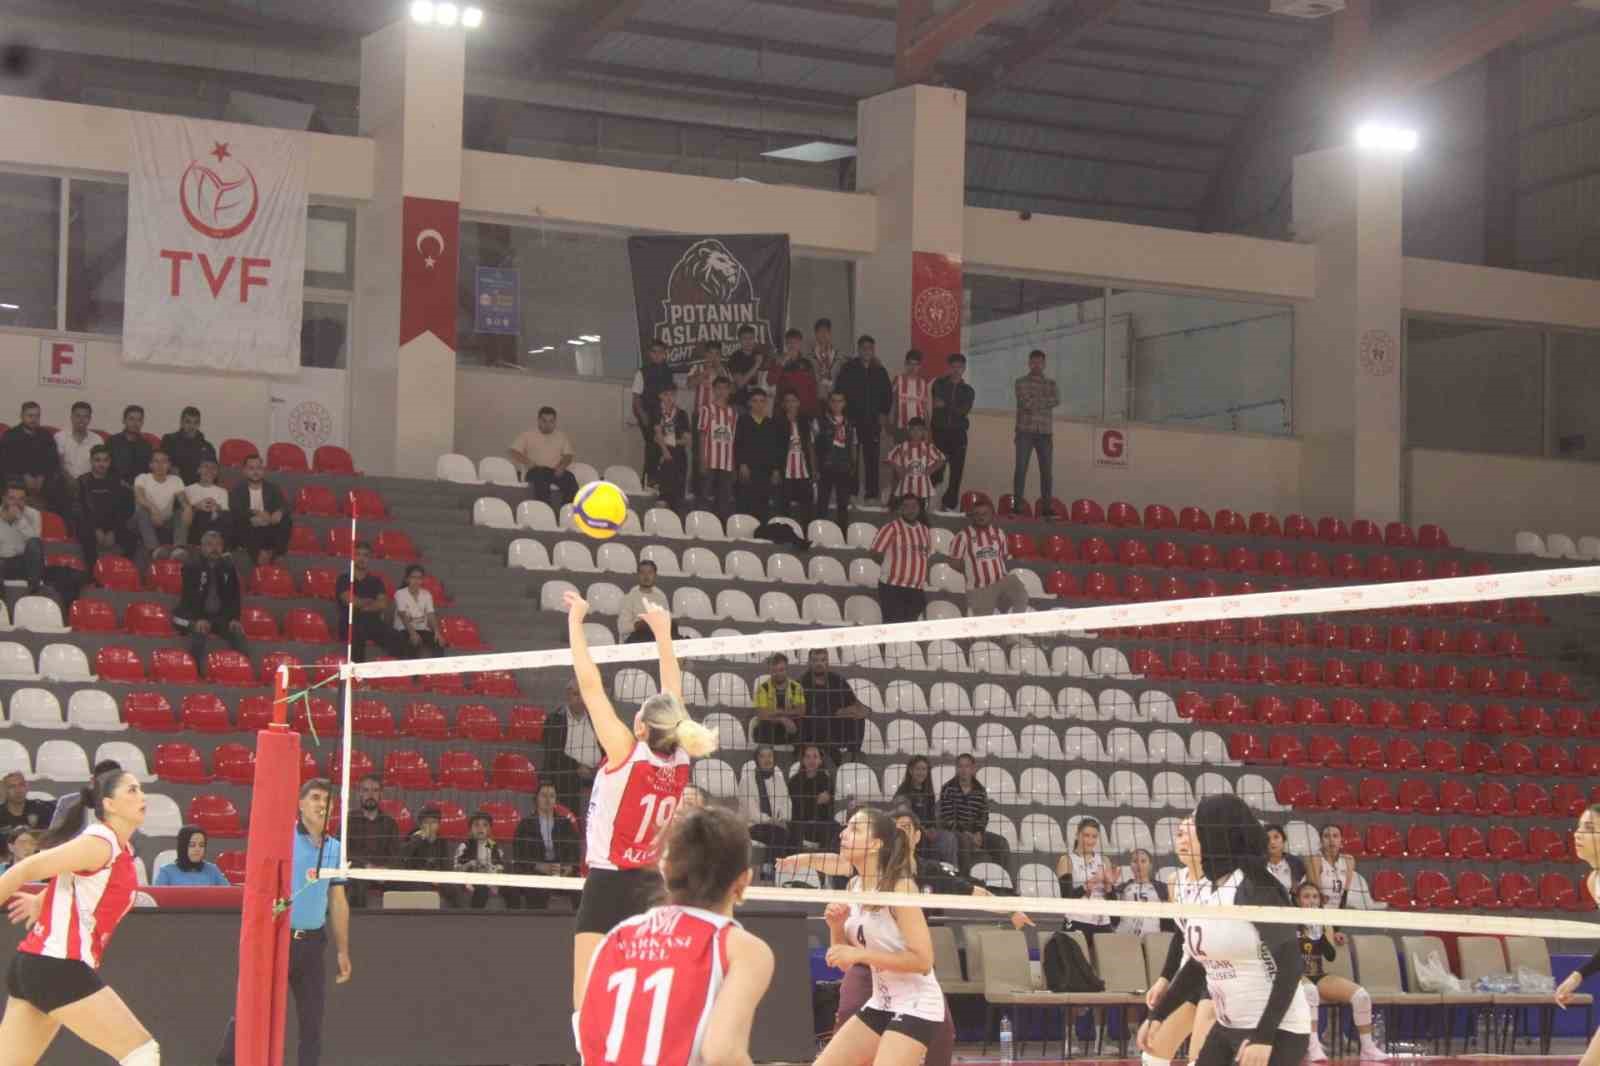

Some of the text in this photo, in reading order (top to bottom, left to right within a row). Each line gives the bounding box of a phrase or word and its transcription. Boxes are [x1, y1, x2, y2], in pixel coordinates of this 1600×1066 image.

[160, 249, 271, 303] TVF
[670, 302, 754, 325] POTANIN
[51, 343, 74, 375] F
[1102, 430, 1123, 458] G
[857, 924, 867, 949] 4
[1188, 925, 1207, 957] 12
[607, 967, 675, 1066] 11
